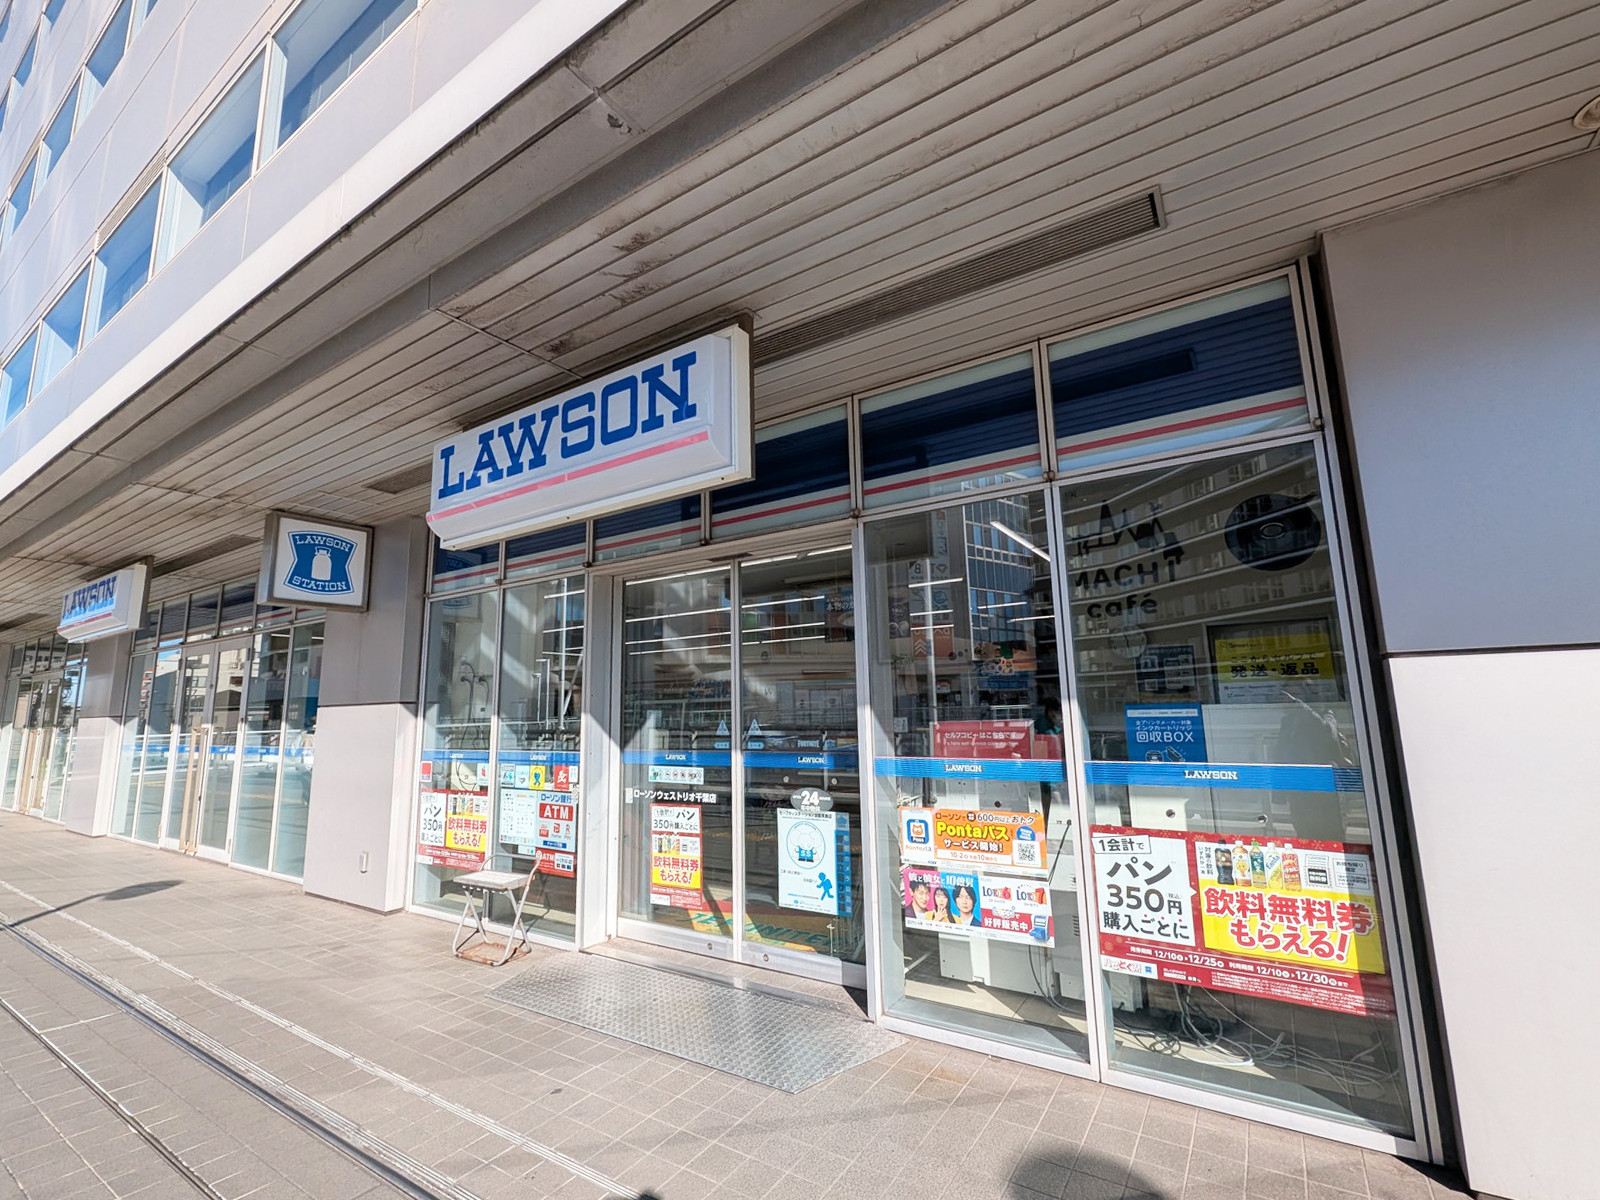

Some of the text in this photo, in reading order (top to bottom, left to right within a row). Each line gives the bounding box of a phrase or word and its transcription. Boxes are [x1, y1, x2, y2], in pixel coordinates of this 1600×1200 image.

[438, 351, 698, 500] LAWSON
[295, 535, 351, 552] LAWSON
[292, 575, 347, 591] STATION
[62, 576, 117, 620] LAWSON
[1087, 593, 1158, 619] café
[1231, 662, 1320, 678] 発送・返品
[797, 739, 820, 748] FORTNITE
[1136, 731, 1194, 743] 回収BOX
[798, 756, 824, 764] LAWSON
[945, 764, 982, 772] LAWSON
[1184, 769, 1238, 780] LAWSON
[541, 794, 572, 803] ローソン銀行
[633, 789, 717, 804] ローソンウェストリオ千葉店
[801, 790, 819, 806] 24
[424, 804, 442, 818] パン
[543, 805, 569, 820] ATM
[676, 809, 696, 821] パン
[448, 817, 487, 834] 飲料無料券
[935, 820, 1010, 841] Pontaパス
[1099, 838, 1145, 852] 1会計で
[653, 856, 700, 872] 飲料無料券
[1106, 856, 1173, 886] パン
[1106, 884, 1183, 916] 350円
[1205, 888, 1374, 934] 飲料無料券
[984, 917, 1029, 932] 好評販売中
[1103, 911, 1190, 939] 購入ごとに
